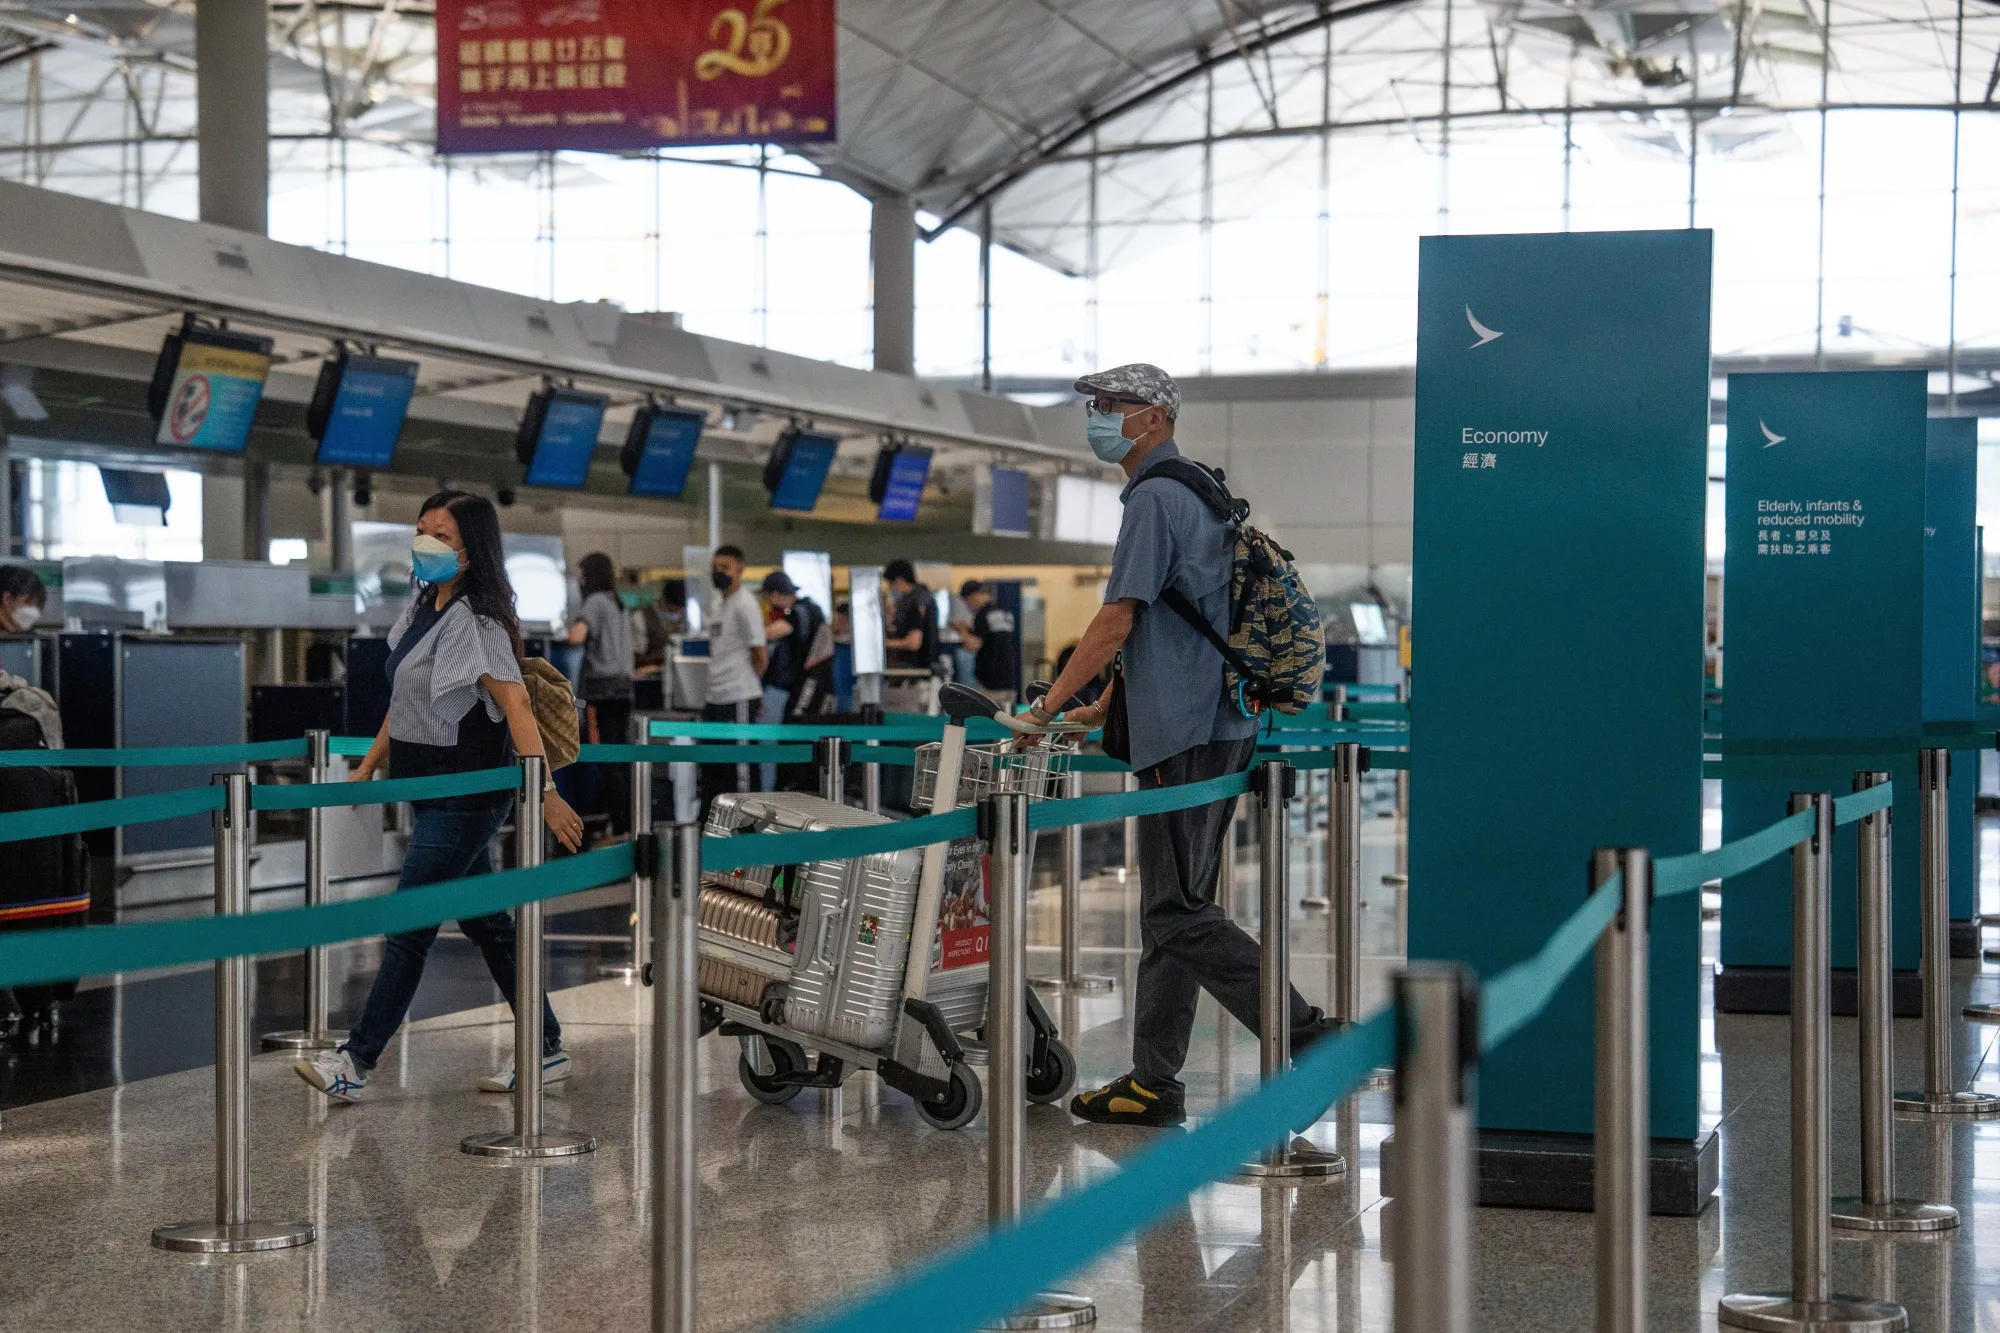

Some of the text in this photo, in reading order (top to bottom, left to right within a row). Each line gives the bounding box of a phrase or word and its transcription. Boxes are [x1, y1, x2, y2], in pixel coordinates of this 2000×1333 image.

[1462, 427, 1549, 447] Economy
[1462, 452, 1497, 469] 經濟
[1757, 500, 1863, 513] Elderly, infants &
[1757, 514, 1865, 527] reduced mobility
[1757, 543, 1832, 555] 需扶助之乘客
[953, 845, 966, 857] Eyes
[954, 938, 973, 948] PRODUCT
